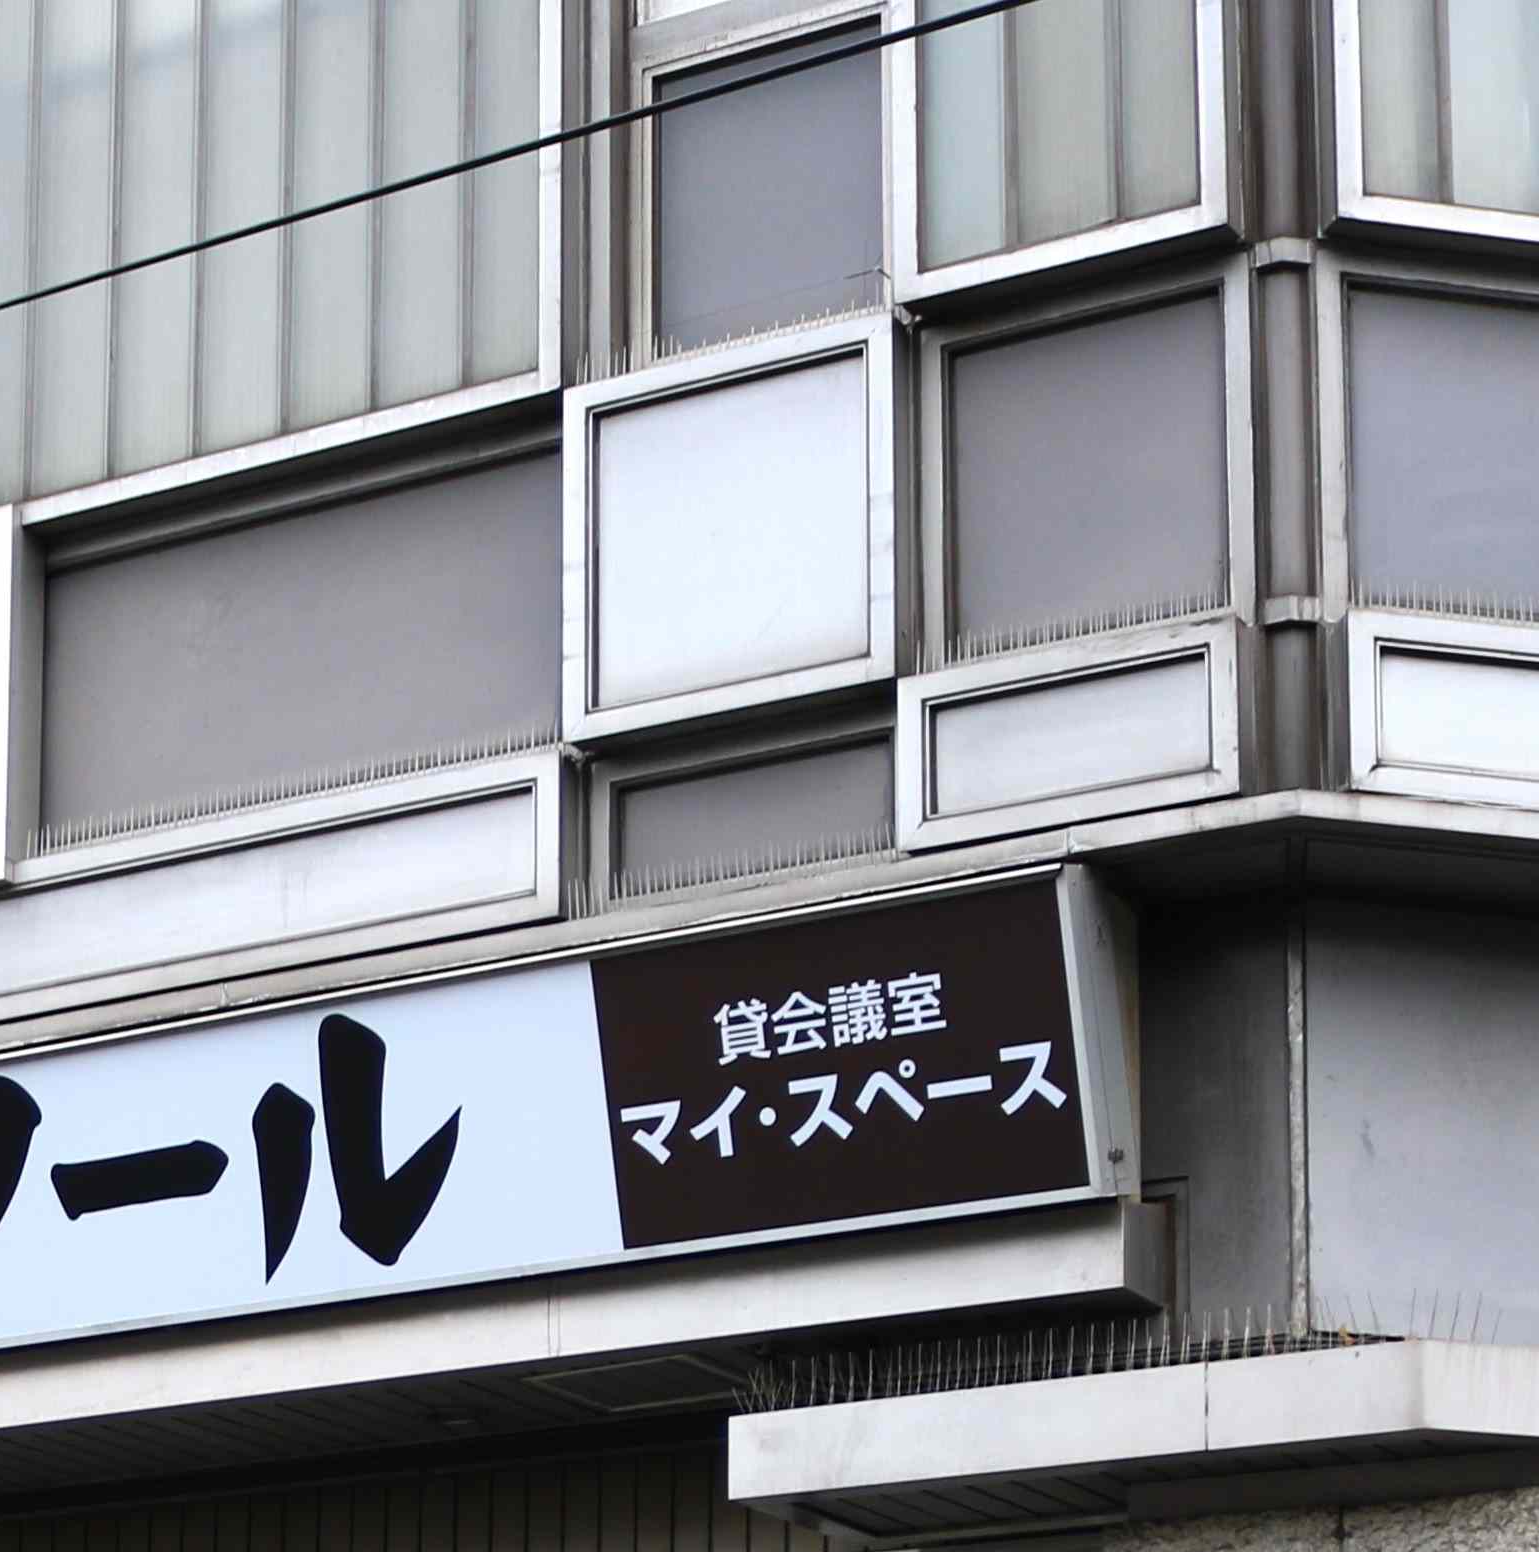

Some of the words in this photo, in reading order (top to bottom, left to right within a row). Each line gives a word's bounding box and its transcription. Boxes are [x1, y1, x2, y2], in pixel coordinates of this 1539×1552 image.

[713, 972, 947, 1065] 貸会議室
[619, 1040, 1067, 1165] マイ・スペース
